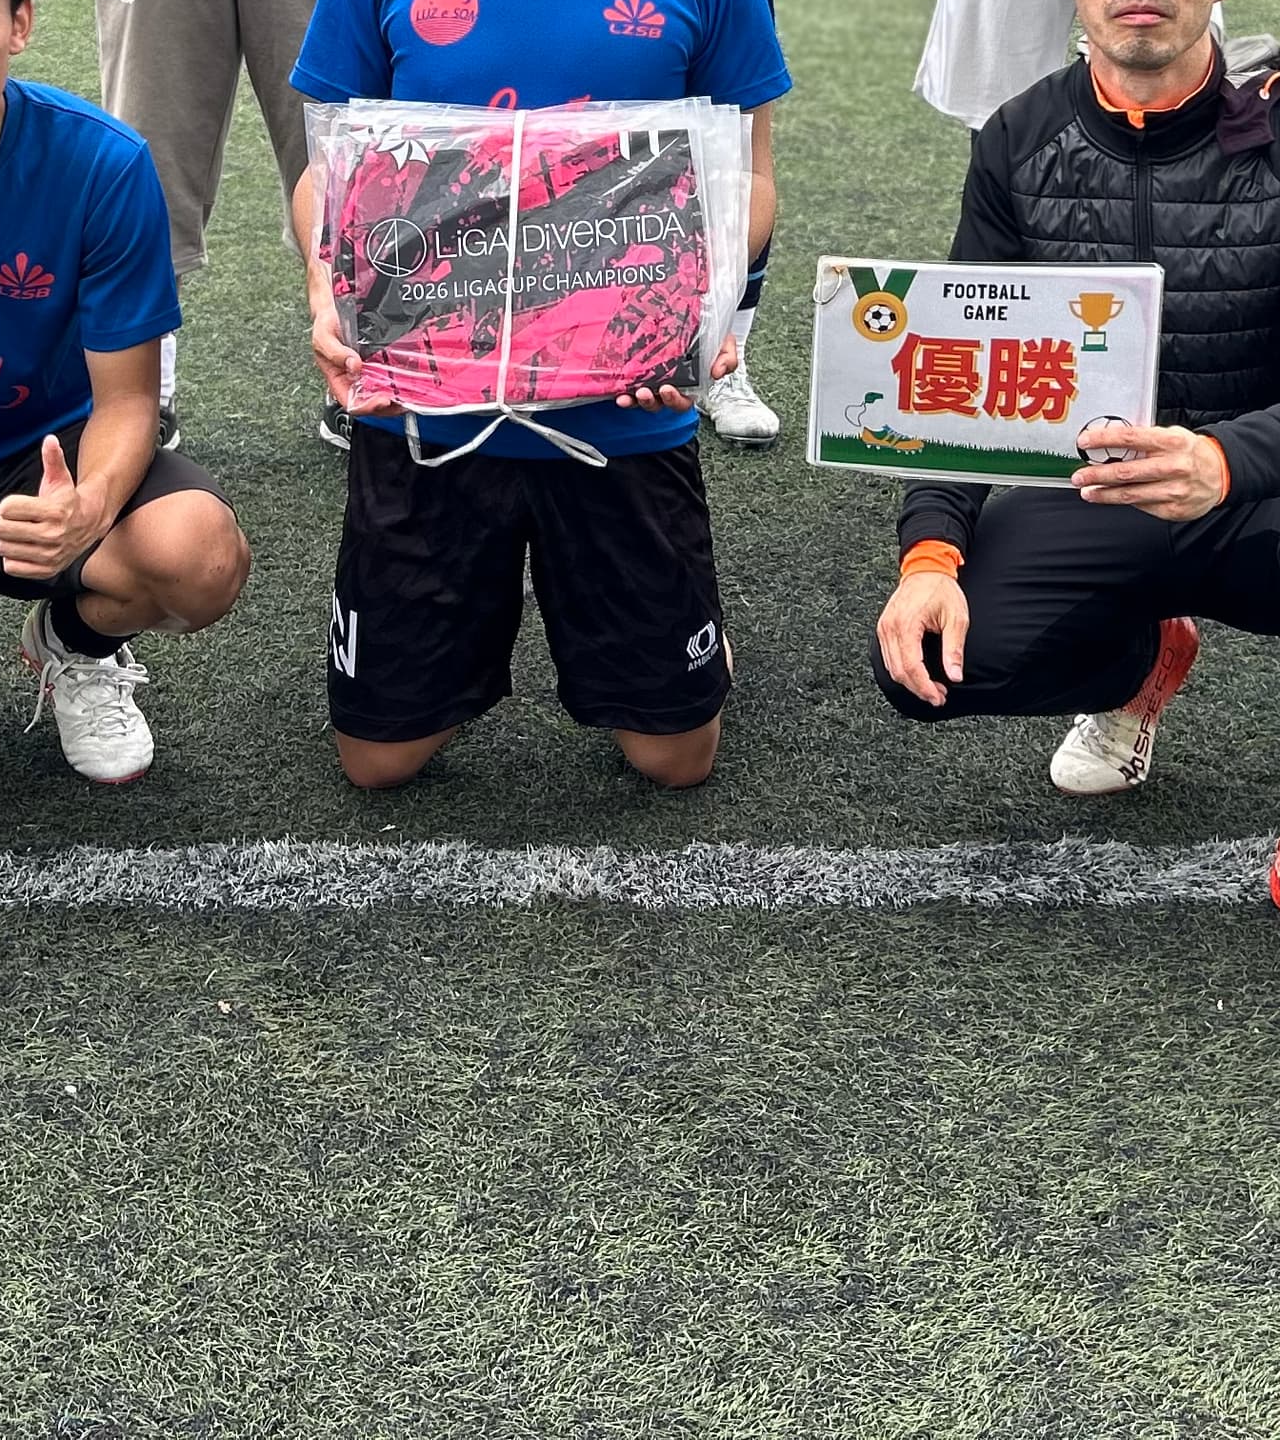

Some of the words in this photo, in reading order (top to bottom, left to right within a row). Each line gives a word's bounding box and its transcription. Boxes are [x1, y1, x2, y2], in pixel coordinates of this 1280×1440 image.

[608, 23, 662, 39] LZSB
[401, 282, 450, 301] 2026
[453, 273, 537, 299] LIGACUP
[542, 263, 667, 292] CHAMPIONS
[943, 283, 1031, 301] FOOTBALL
[963, 304, 1008, 321] GAME
[891, 332, 1080, 424] 優勝
